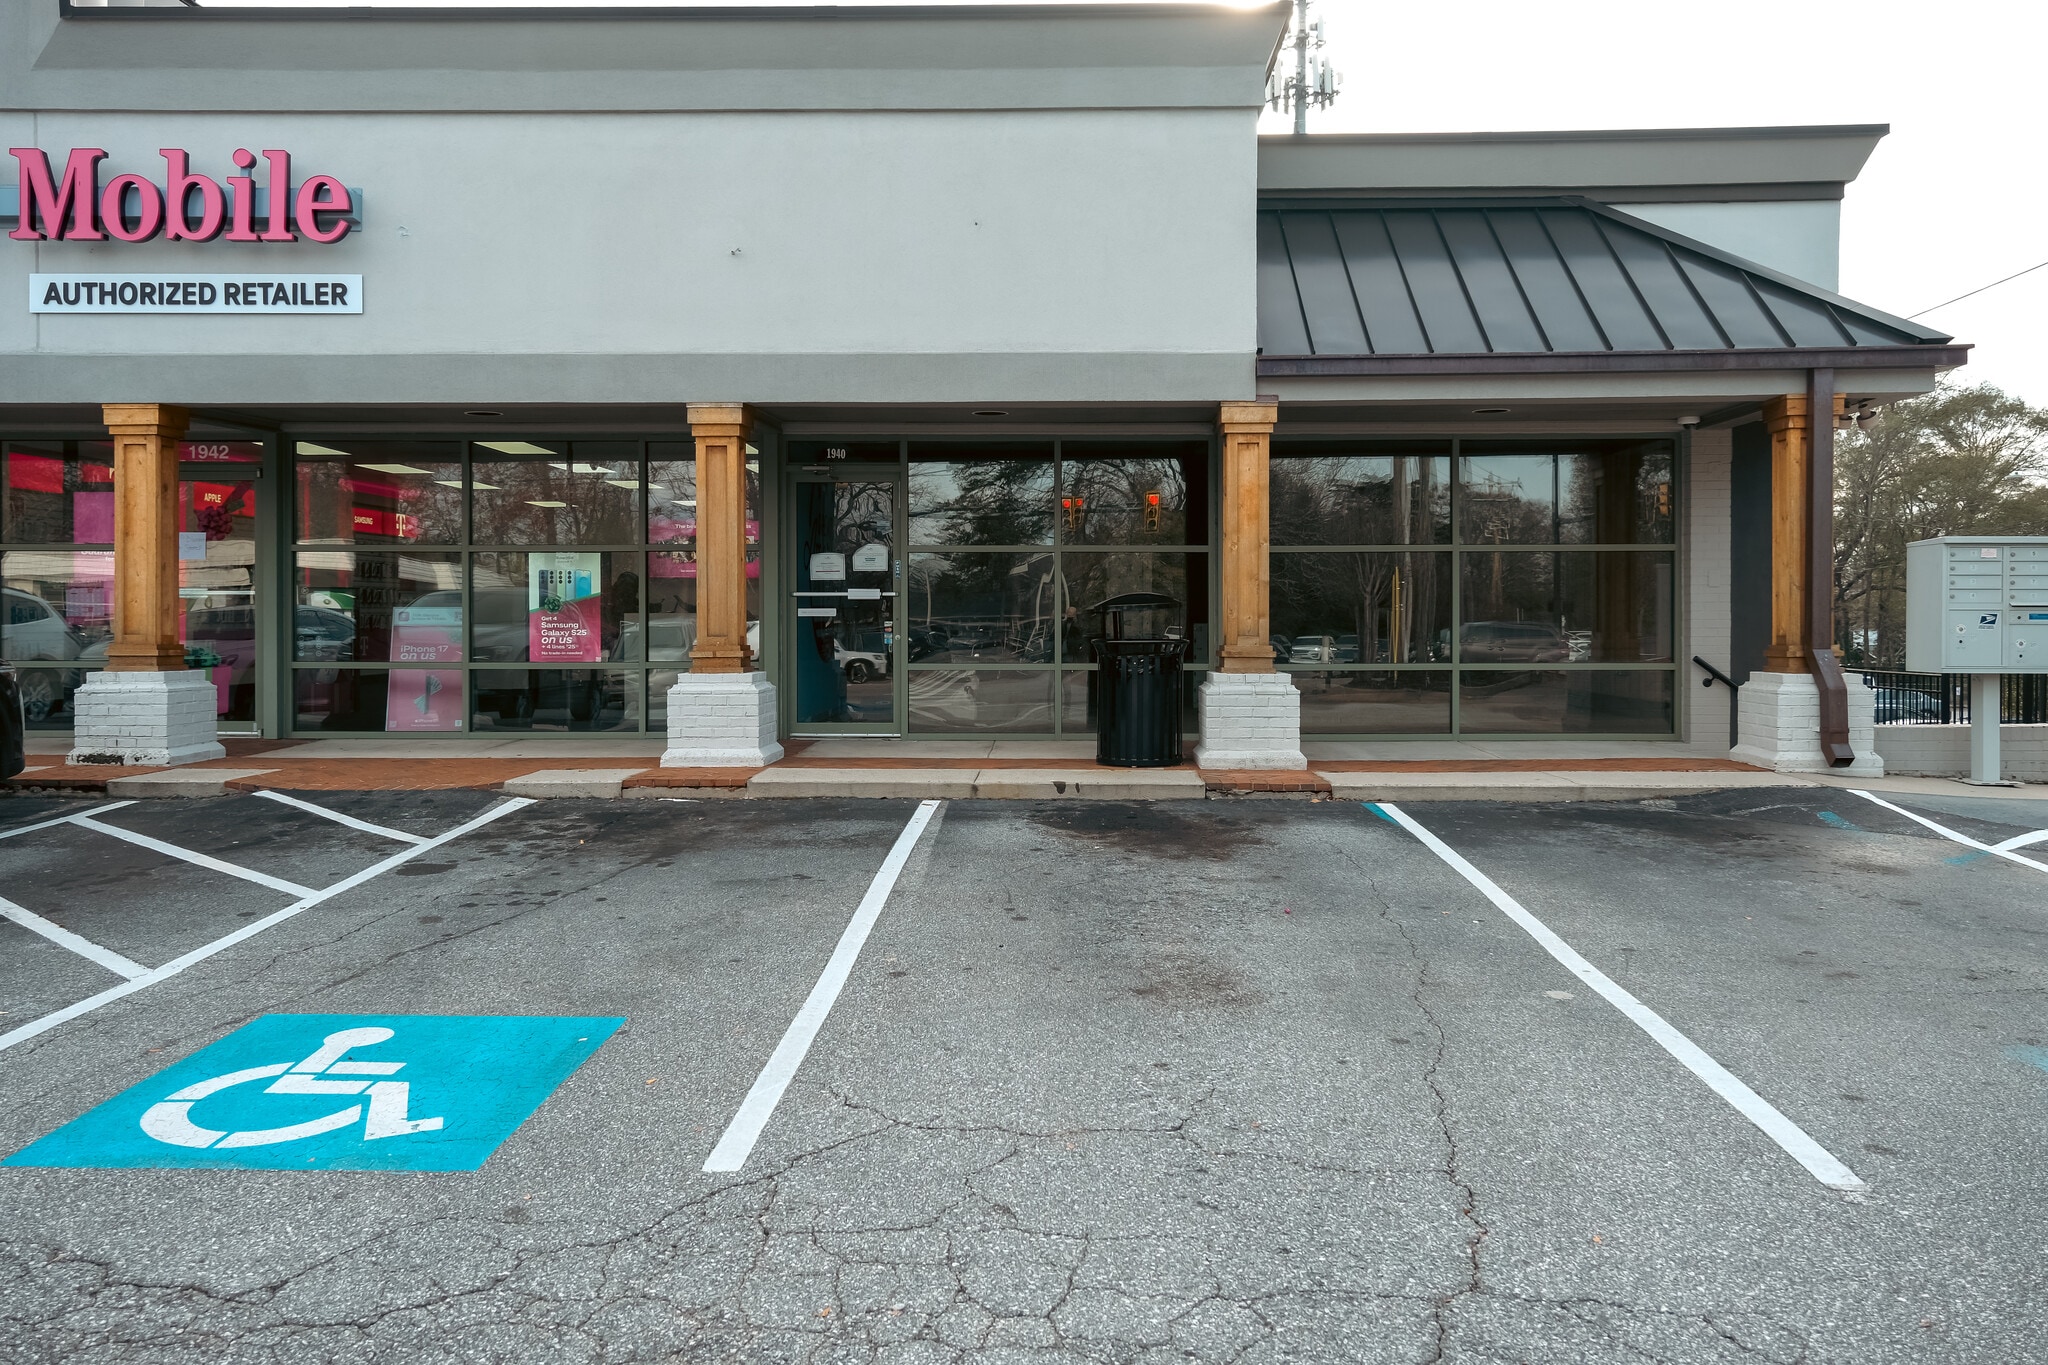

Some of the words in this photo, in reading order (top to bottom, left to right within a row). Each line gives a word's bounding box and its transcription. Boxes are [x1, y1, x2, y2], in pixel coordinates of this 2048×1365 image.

[8, 147, 354, 244] Mobile
[43, 282, 217, 306] AUTHORIZED
[224, 282, 349, 306] RETAILER
[189, 445, 229, 459] 1942
[826, 448, 846, 459] 1940
[204, 493, 222, 503] APPLE
[354, 515, 373, 525] SAMSUNG
[541, 621, 579, 629] Samsung
[541, 629, 570, 637] Galaxy
[400, 645, 436, 653] iPhone
[437, 645, 449, 653] 17
[400, 652, 418, 660] on
[421, 652, 436, 660] us
